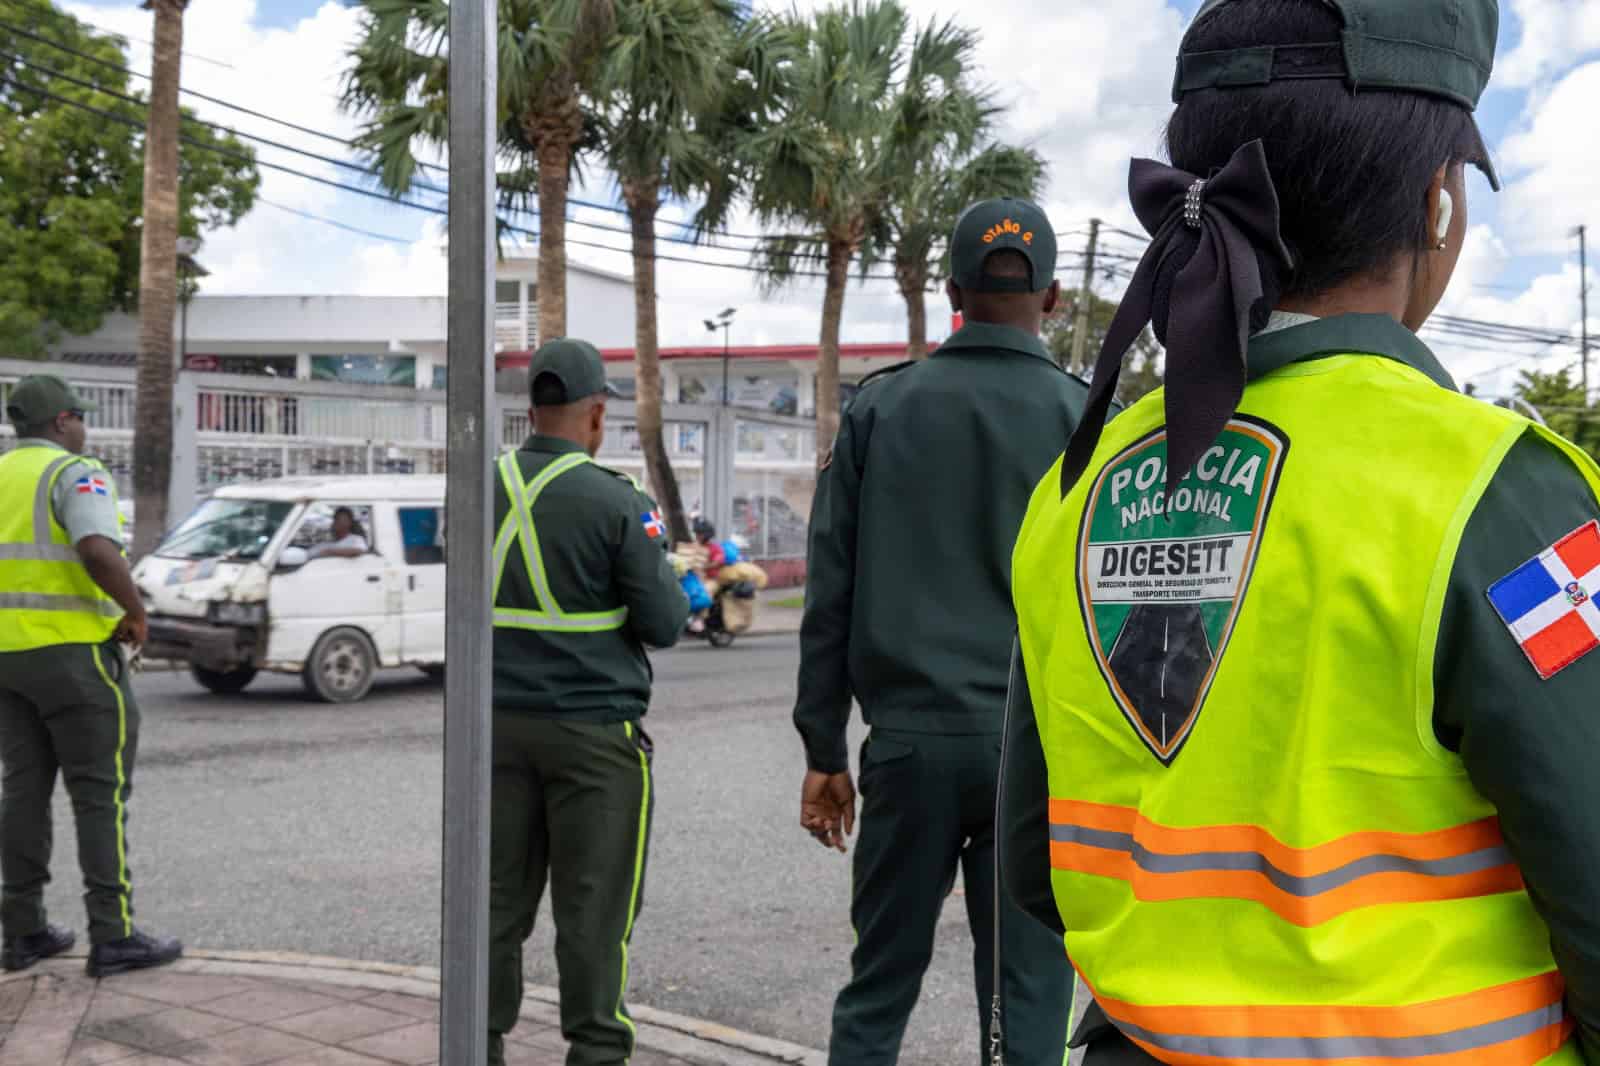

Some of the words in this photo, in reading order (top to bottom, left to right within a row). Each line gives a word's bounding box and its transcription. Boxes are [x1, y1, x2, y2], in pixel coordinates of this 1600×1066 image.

[983, 218, 1020, 243] OTAÑO
[1111, 446, 1262, 505] POCIA
[1121, 488, 1232, 528] NACIONAL
[1100, 540, 1233, 577] DIGESETT
